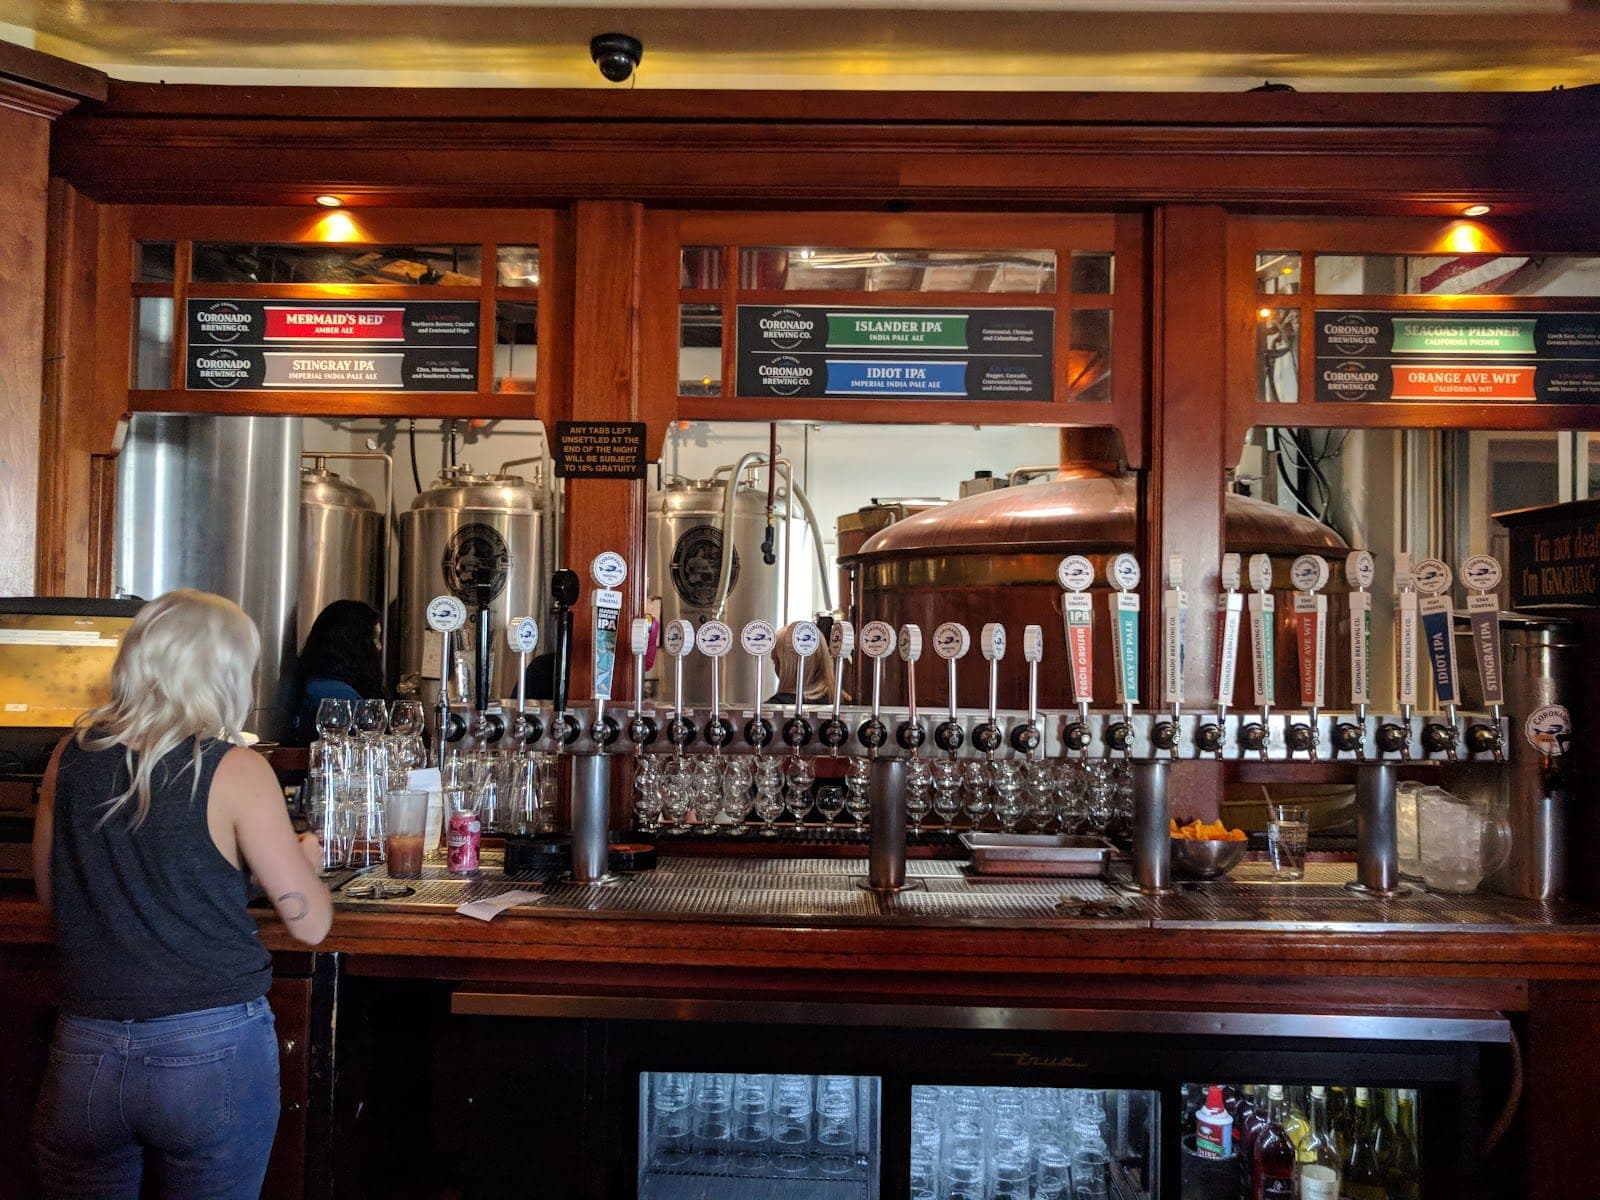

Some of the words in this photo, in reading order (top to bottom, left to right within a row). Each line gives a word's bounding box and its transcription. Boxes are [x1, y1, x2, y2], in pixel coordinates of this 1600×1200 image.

[196, 311, 252, 323] CORONADO
[286, 313, 356, 325] MERMAID'S
[358, 314, 384, 325] RED
[237, 324, 250, 332] CO.
[314, 326, 339, 334] AMBER
[340, 326, 355, 334] ALE
[760, 318, 814, 330] CORONADO
[855, 320, 918, 332] ISLANDER
[921, 321, 943, 332] IPA
[1324, 323, 1379, 335] CORONADO
[1404, 325, 1464, 336] SEACOAST
[1468, 326, 1520, 336] PILSNER
[1327, 336, 1364, 344] BREWING
[1364, 336, 1377, 344] CO.
[1424, 338, 1468, 346] CALIFORNIA
[196, 357, 251, 369] CORONADO
[292, 359, 351, 371] STINGRAY
[353, 360, 375, 371] IPA
[236, 370, 249, 378] CO.
[288, 372, 322, 380] IMPERIAL
[324, 372, 345, 380] INDIA
[759, 365, 813, 377] CORONADO
[867, 367, 902, 378] IDIOT
[904, 368, 926, 379] IPA
[1323, 370, 1379, 382] CORONADO
[762, 377, 798, 385] BREWING
[1408, 372, 1461, 383] ORANGE
[1492, 372, 1519, 384] WIT
[569, 426, 586, 434] ANY
[623, 436, 640, 444] THE
[563, 445, 581, 453] END
[612, 446, 638, 454] NIGHT
[586, 455, 597, 463] BE
[599, 455, 637, 463] SUBJECT
[564, 464, 576, 472] TO
[595, 465, 637, 473] GRATUITY
[1541, 563, 1596, 595] IGNORING
[597, 618, 617, 630] IPA
[1303, 617, 1311, 636] WIT
[1125, 620, 1134, 645] PALE
[1480, 622, 1492, 639] IPA
[1169, 627, 1177, 657] BREWING
[1432, 631, 1445, 651] IPA
[1126, 647, 1134, 661] UP
[1434, 654, 1449, 684] IDIOT
[1481, 641, 1498, 691] STINGRAY
[1126, 664, 1136, 690] EASY
[1169, 659, 1177, 693] CORONADO
[1256, 660, 1264, 696] CORONADO
[1304, 657, 1312, 694] ORANGE
